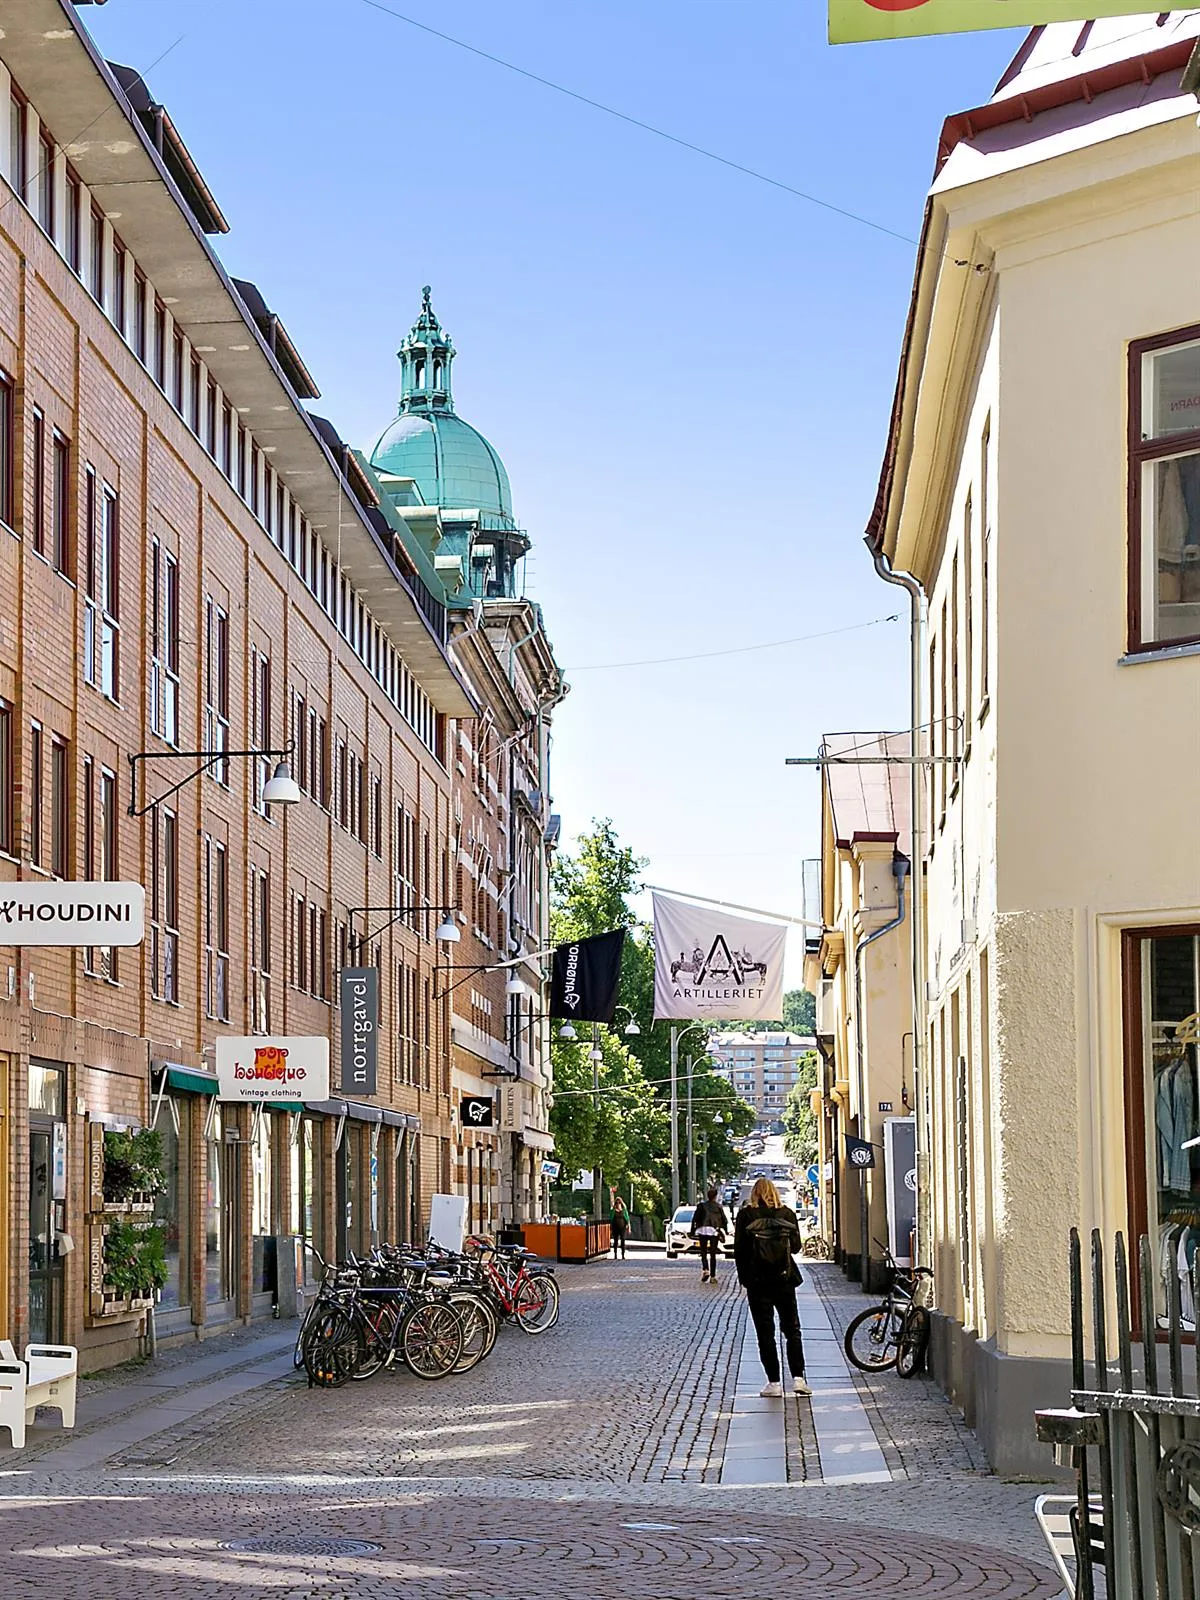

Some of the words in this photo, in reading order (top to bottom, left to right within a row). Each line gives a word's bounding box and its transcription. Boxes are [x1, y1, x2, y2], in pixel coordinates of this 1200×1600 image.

[17, 903, 130, 922] HOUDINI
[696, 934, 743, 986] A
[673, 988, 764, 999] ARTILLERIET
[345, 976, 373, 1083] norrgavel
[254, 1047, 289, 1065] pop
[233, 1062, 307, 1085] boutique
[240, 1089, 269, 1098] Vintage
[271, 1089, 302, 1098] clothing
[506, 1087, 515, 1127] KURORTEN
[92, 1140, 100, 1186] HOUDINI
[92, 1238, 100, 1284] HOUDINI
